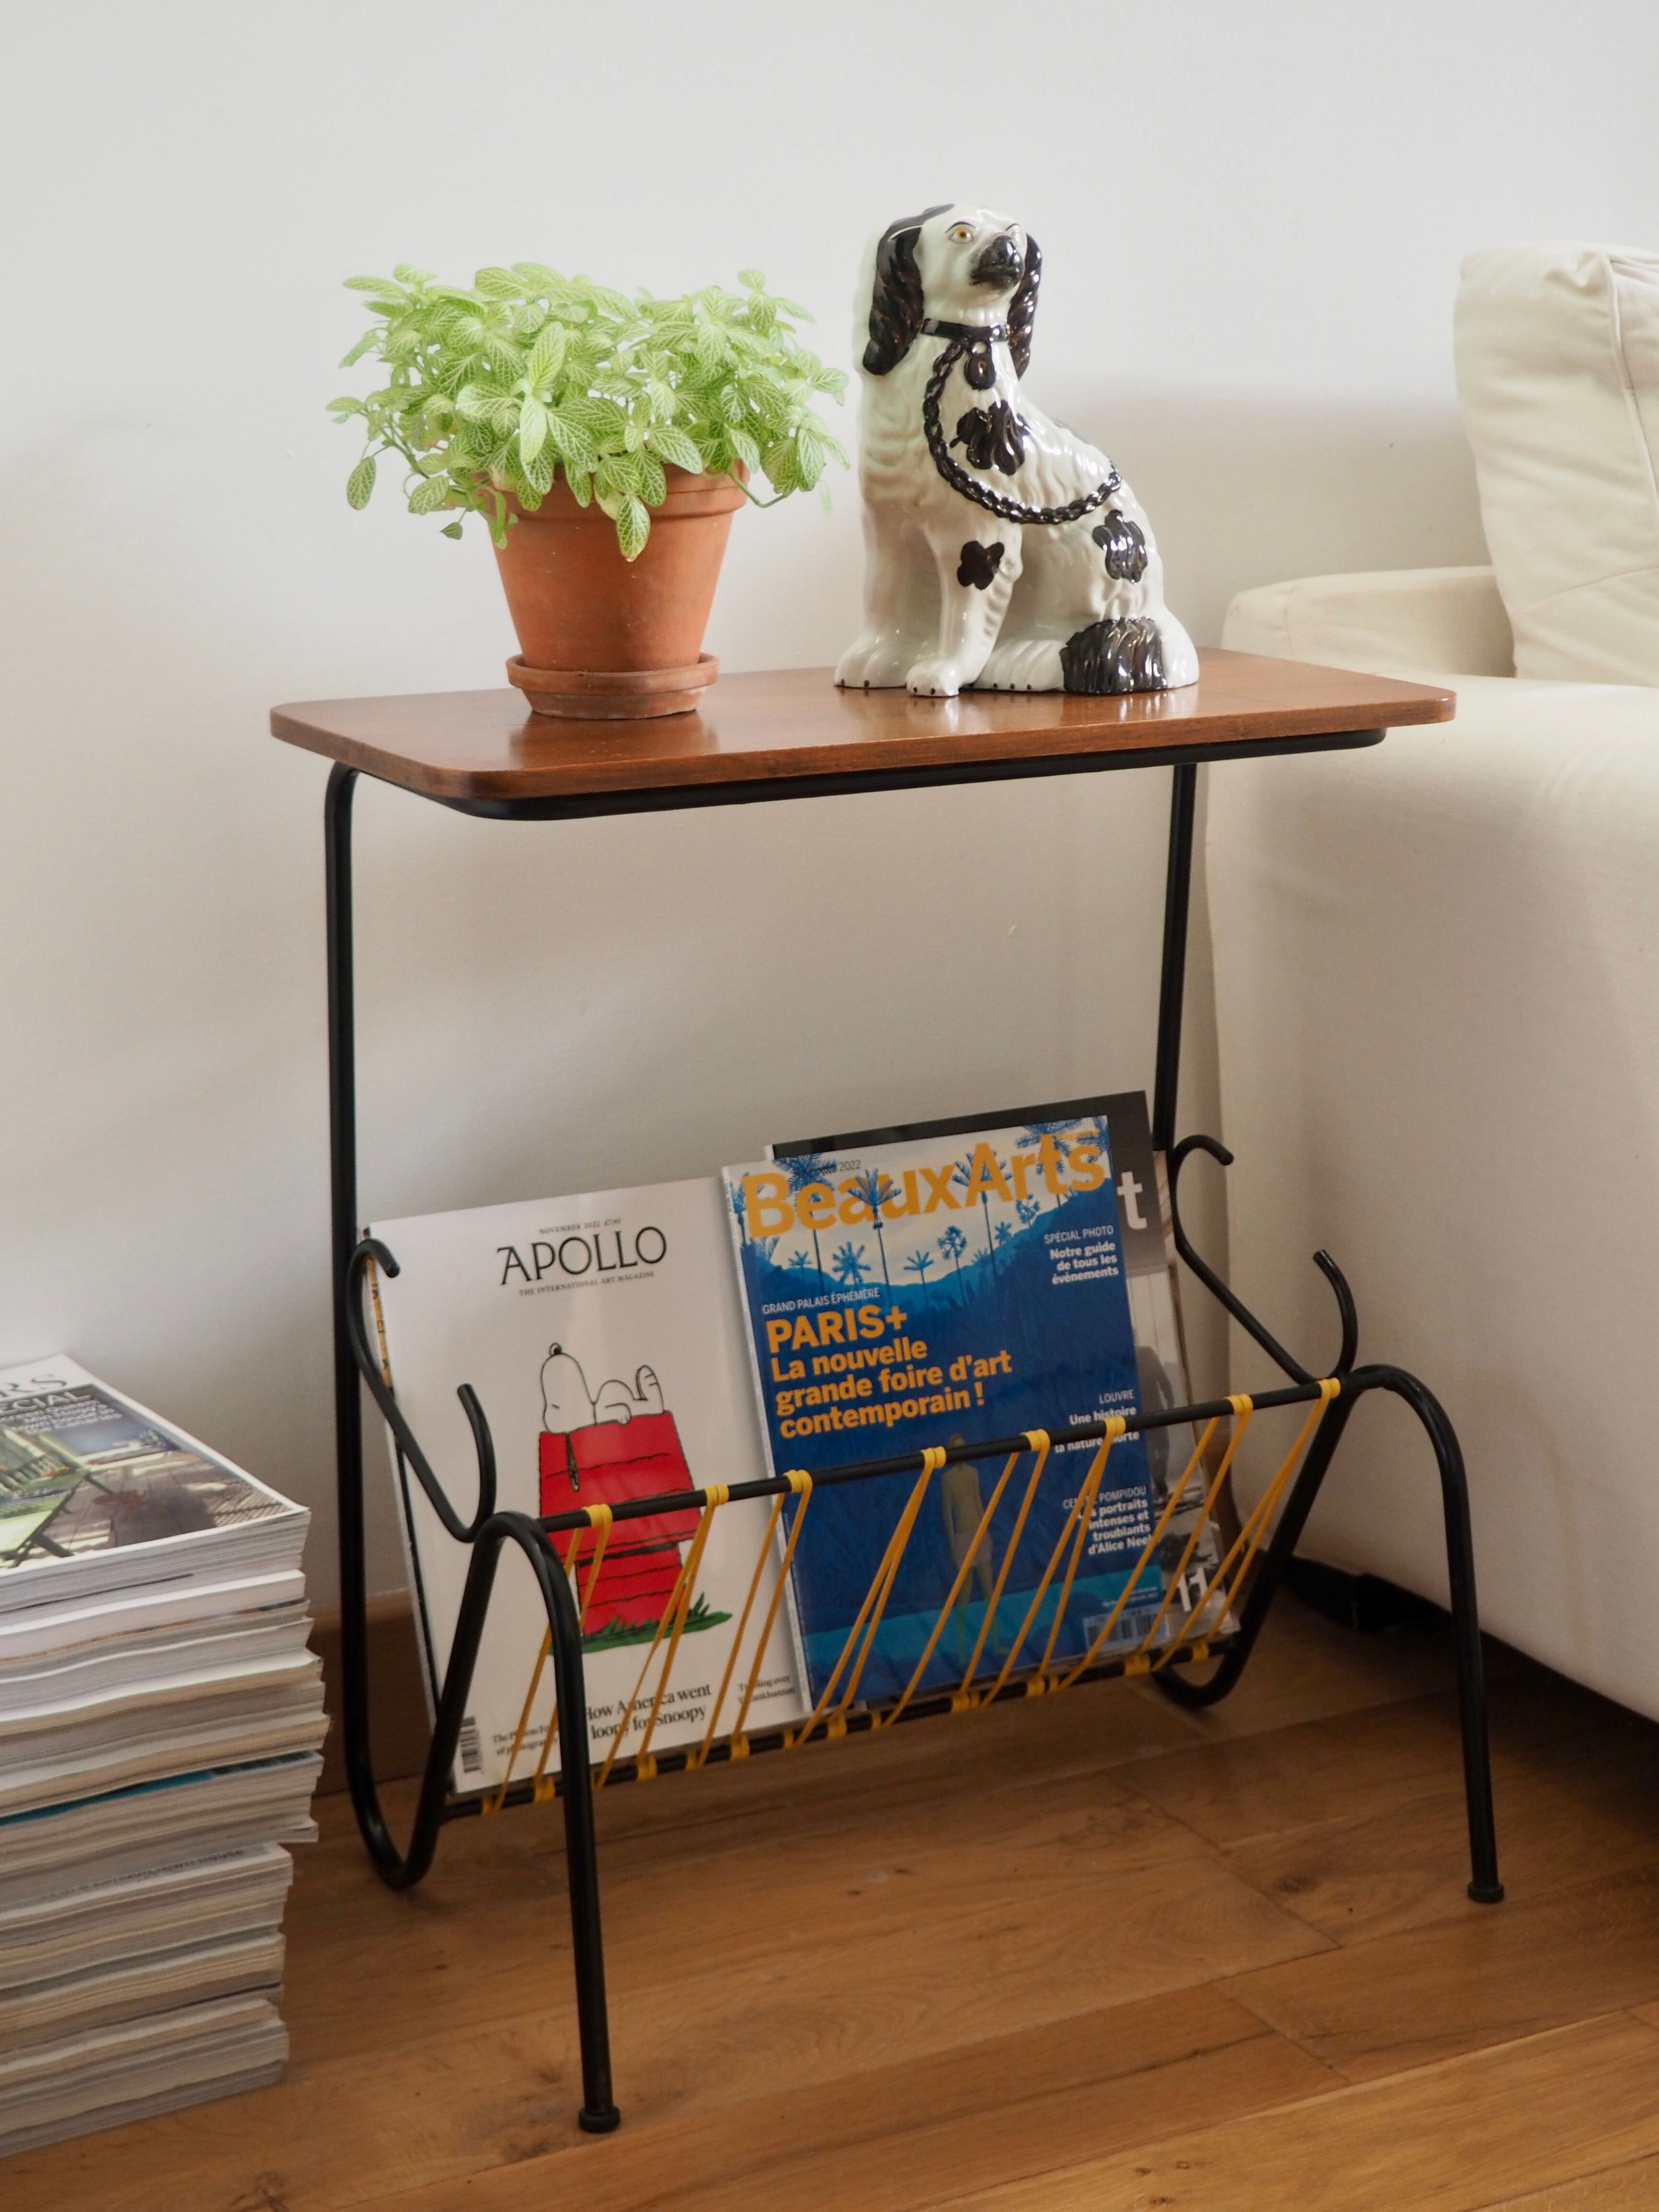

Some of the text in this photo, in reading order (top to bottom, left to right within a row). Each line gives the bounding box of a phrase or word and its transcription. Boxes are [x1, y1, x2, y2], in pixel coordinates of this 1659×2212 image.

[839, 1159, 861, 1172] 2022
[742, 1134, 1107, 1239] BeauxArts
[1117, 1171, 1147, 1229] t
[539, 1222, 581, 1234] NOVEMBER
[584, 1220, 601, 1230] 2022
[1044, 1225, 1114, 1244] SPÉCIAL PHOTO
[496, 1226, 667, 1285] APOLLO
[1050, 1241, 1116, 1259] Notre guide
[1057, 1254, 1117, 1271] de tous les
[537, 1279, 598, 1294] INTERNATIONAL
[601, 1276, 616, 1285] ART
[618, 1271, 655, 1282] MAGAZINE
[1052, 1266, 1119, 1285] événements
[763, 1300, 796, 1315] GRAND
[798, 1295, 830, 1309] PALAIS
[766, 1305, 908, 1354] PARIS+
[771, 1336, 928, 1382] La nouvelle
[775, 1350, 1012, 1416] grande foire d'art
[1099, 1390, 1134, 1404] LOUVRE
[780, 1387, 971, 1439] contemporain
[1070, 1407, 1136, 1425] Une histoire
[1068, 1438, 1103, 1450] nature
[1108, 1431, 1140, 1443] orte
[1100, 1486, 1146, 1502] POMPIDOU
[1100, 1499, 1147, 1516] portraits
[1089, 1511, 1149, 1529] intenses et
[1094, 1524, 1150, 1541] troublants
[1088, 1538, 1123, 1555] d'Alice
[677, 1683, 711, 1700] went
